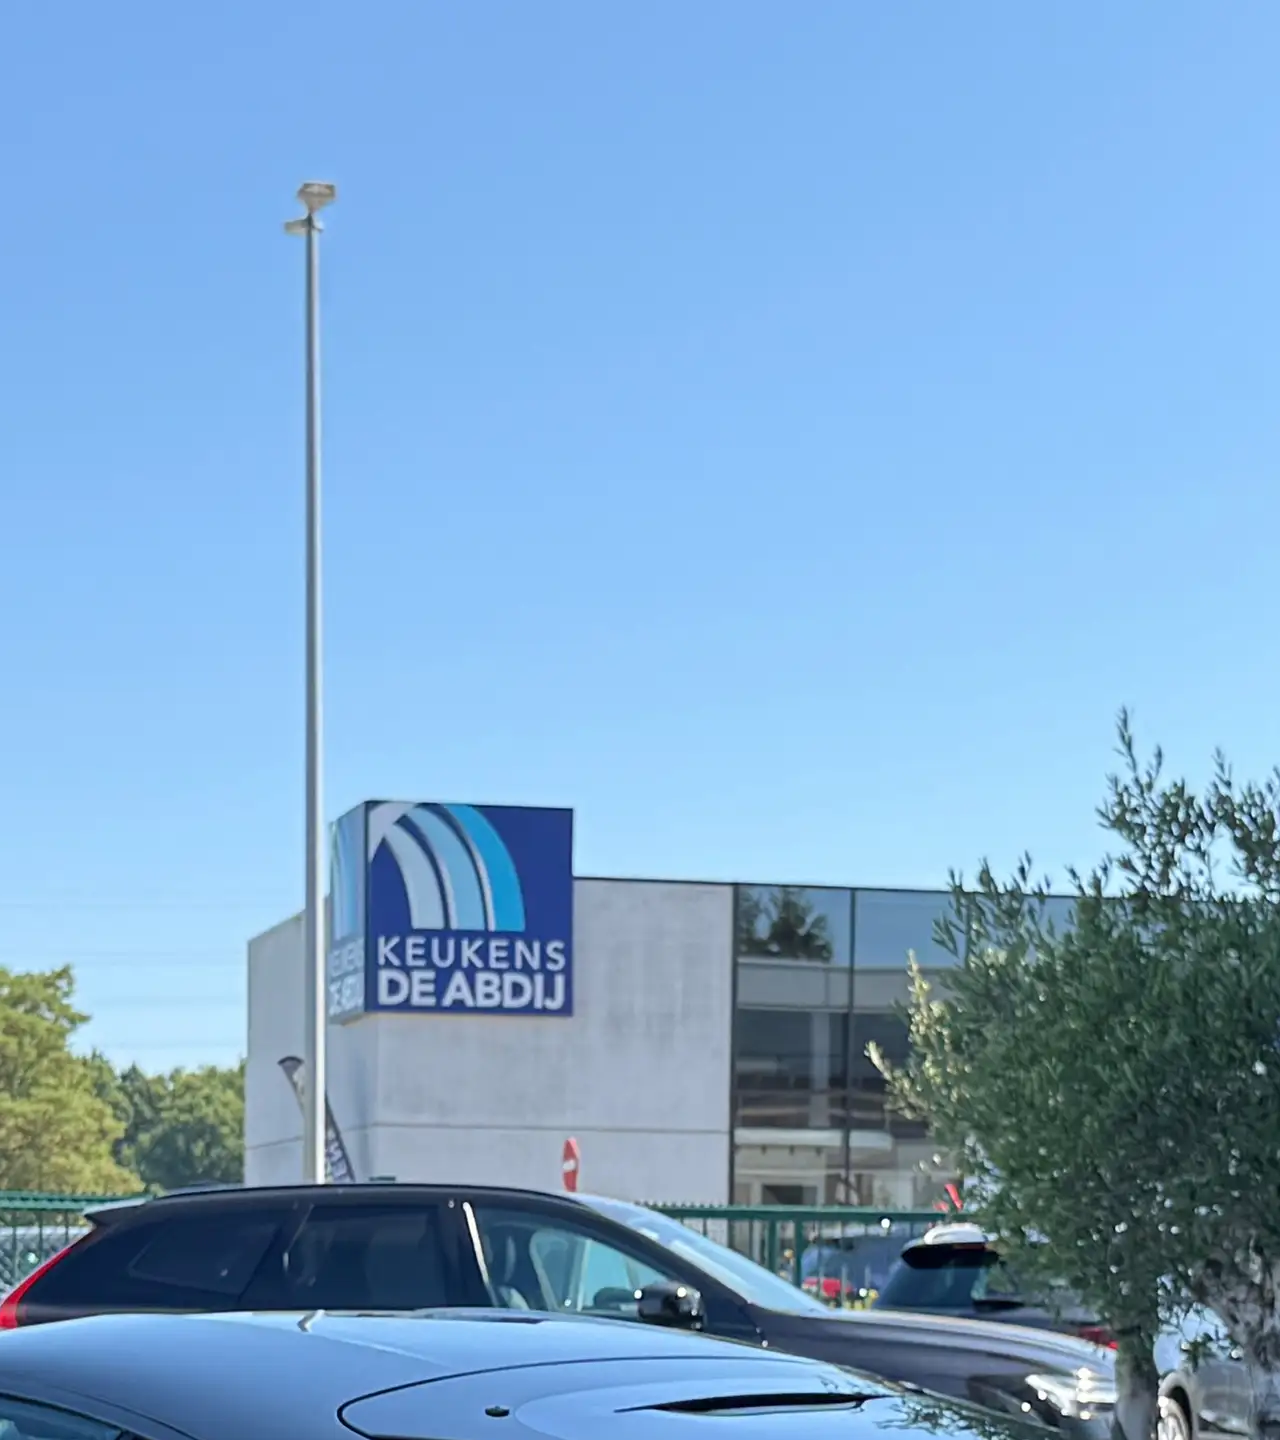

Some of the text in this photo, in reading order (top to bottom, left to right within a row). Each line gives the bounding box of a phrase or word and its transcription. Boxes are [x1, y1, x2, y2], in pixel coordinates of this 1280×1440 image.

[376, 935, 567, 972] KEUKENS
[376, 968, 438, 1007] DE
[440, 970, 567, 1011] ABDIJ
